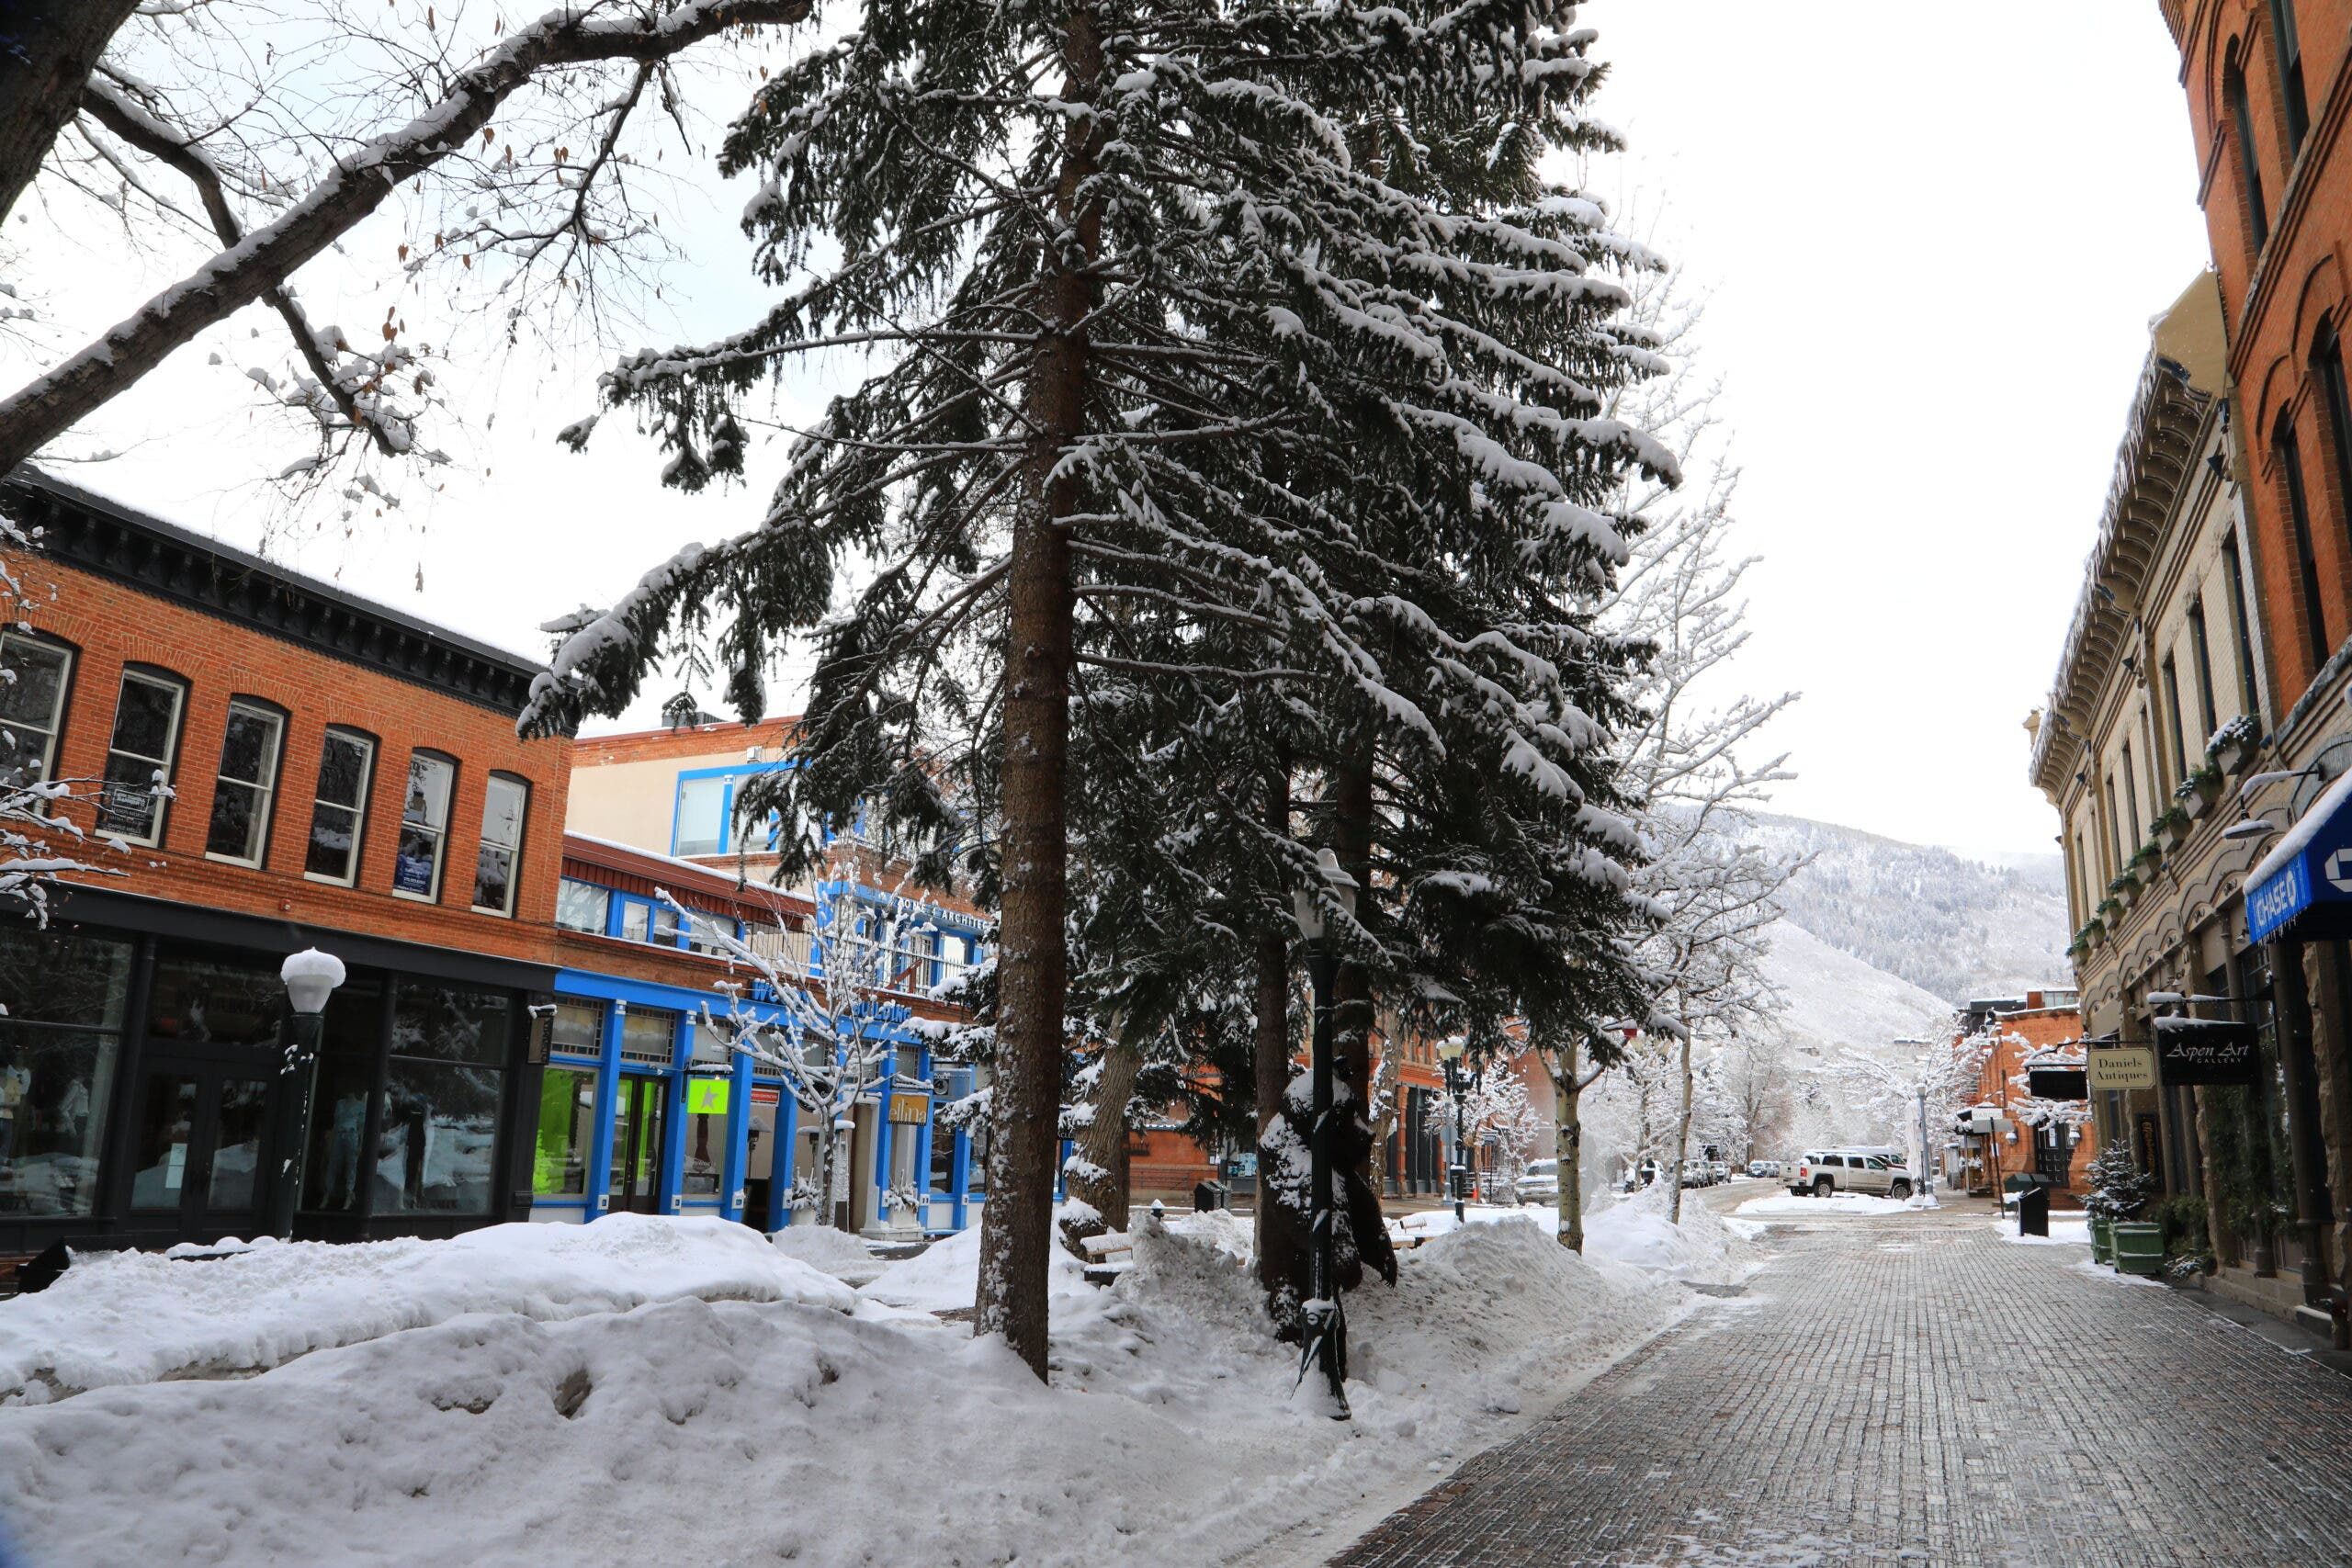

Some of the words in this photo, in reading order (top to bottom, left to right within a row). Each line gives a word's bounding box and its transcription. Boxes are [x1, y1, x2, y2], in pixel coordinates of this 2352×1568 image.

[2256, 880, 2289, 926] CHASE
[2098, 1057, 2143, 1068] Daniels
[2166, 1042, 2213, 1063] Aspen
[2218, 1042, 2250, 1057] Art
[2096, 1069, 2148, 1083] Antiques
[889, 1099, 927, 1123] ellina
